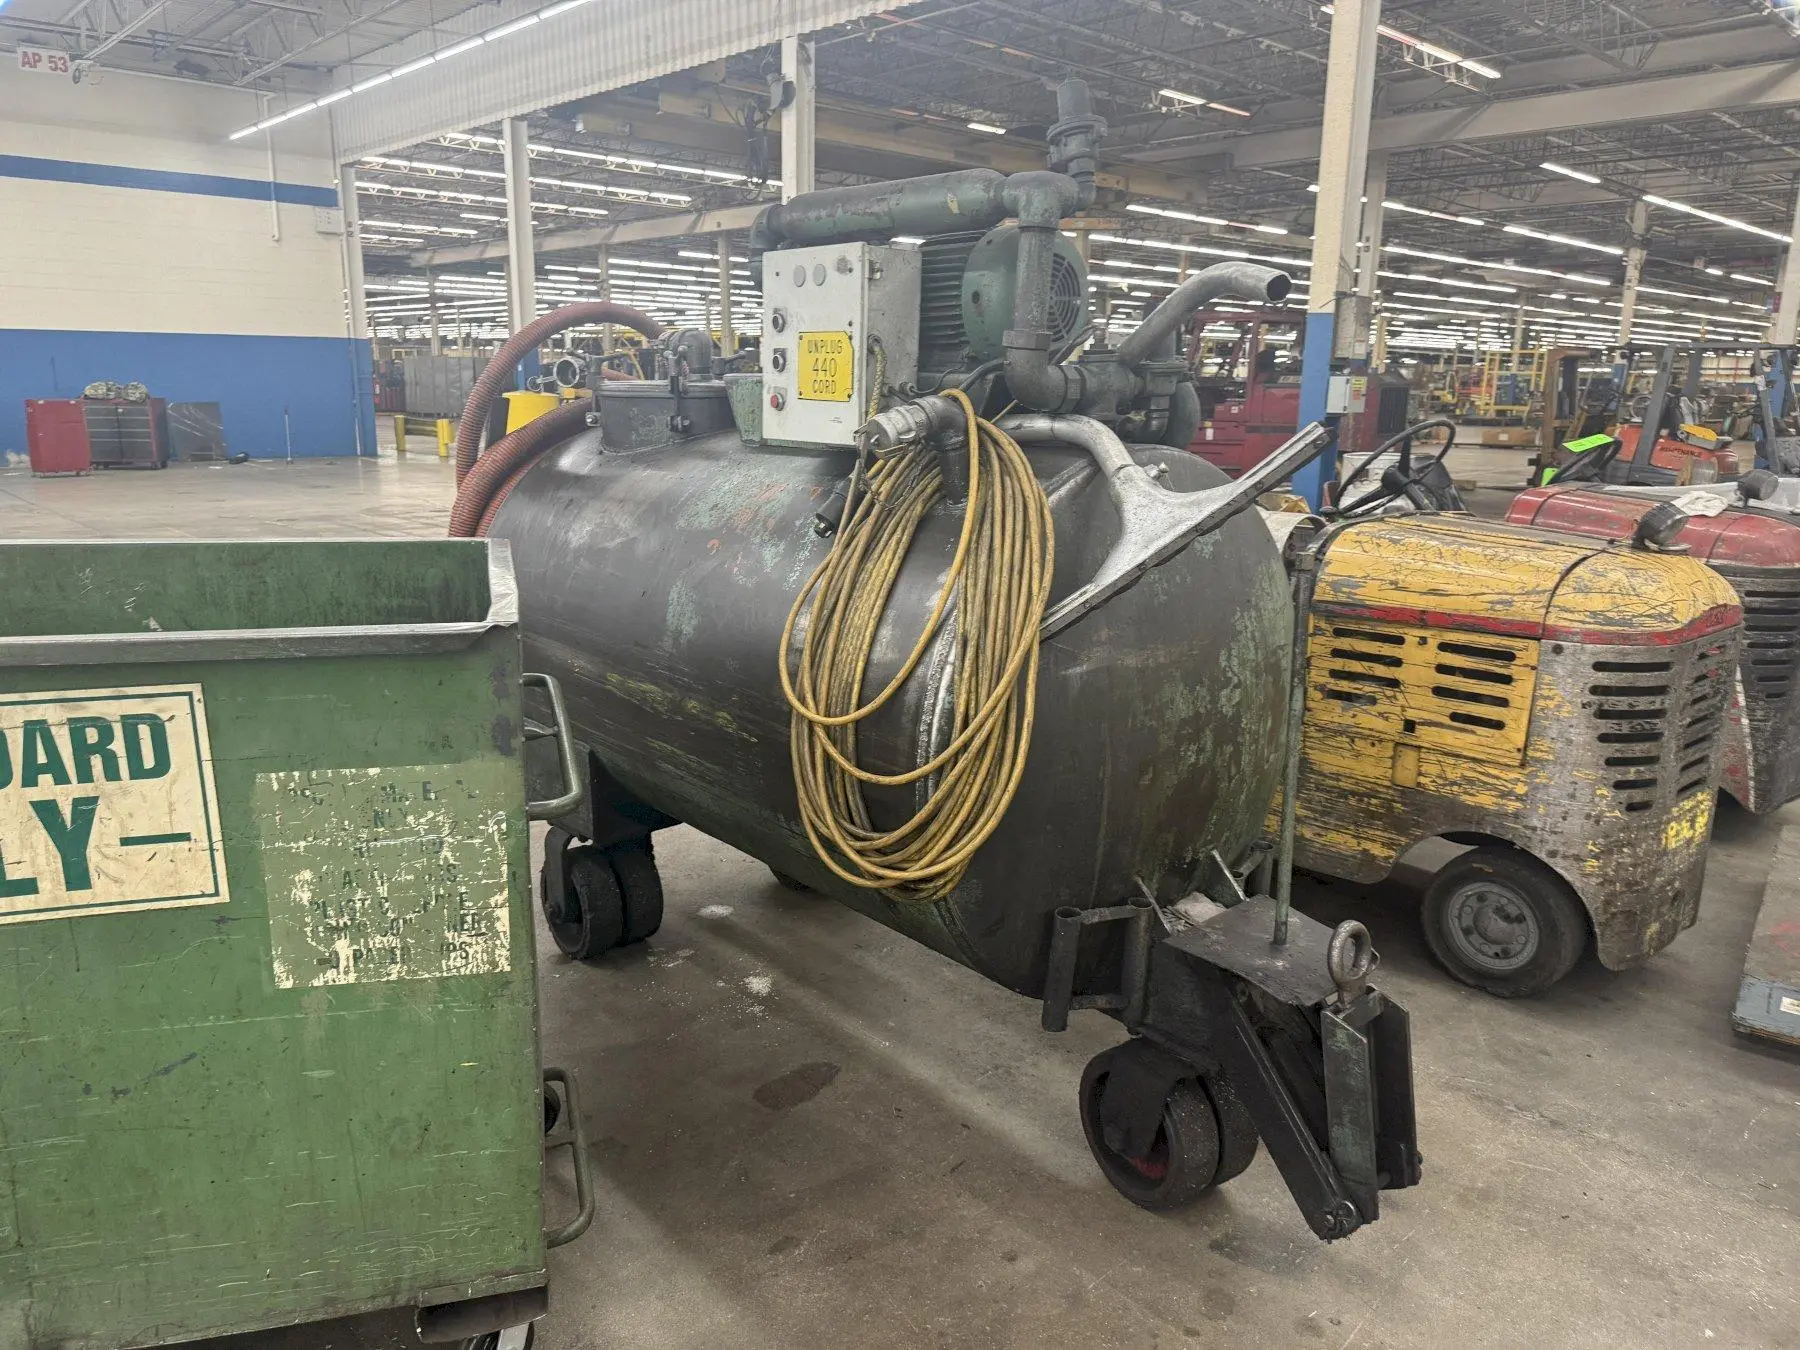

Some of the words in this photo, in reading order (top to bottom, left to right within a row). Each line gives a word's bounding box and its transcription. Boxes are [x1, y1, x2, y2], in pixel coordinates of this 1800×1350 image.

[21, 51, 42, 69] AP
[48, 55, 69, 73] 53
[807, 339, 843, 354] UNPLUG
[812, 357, 838, 378] 440
[812, 379, 837, 394] CORD
[0, 713, 171, 789] ARD
